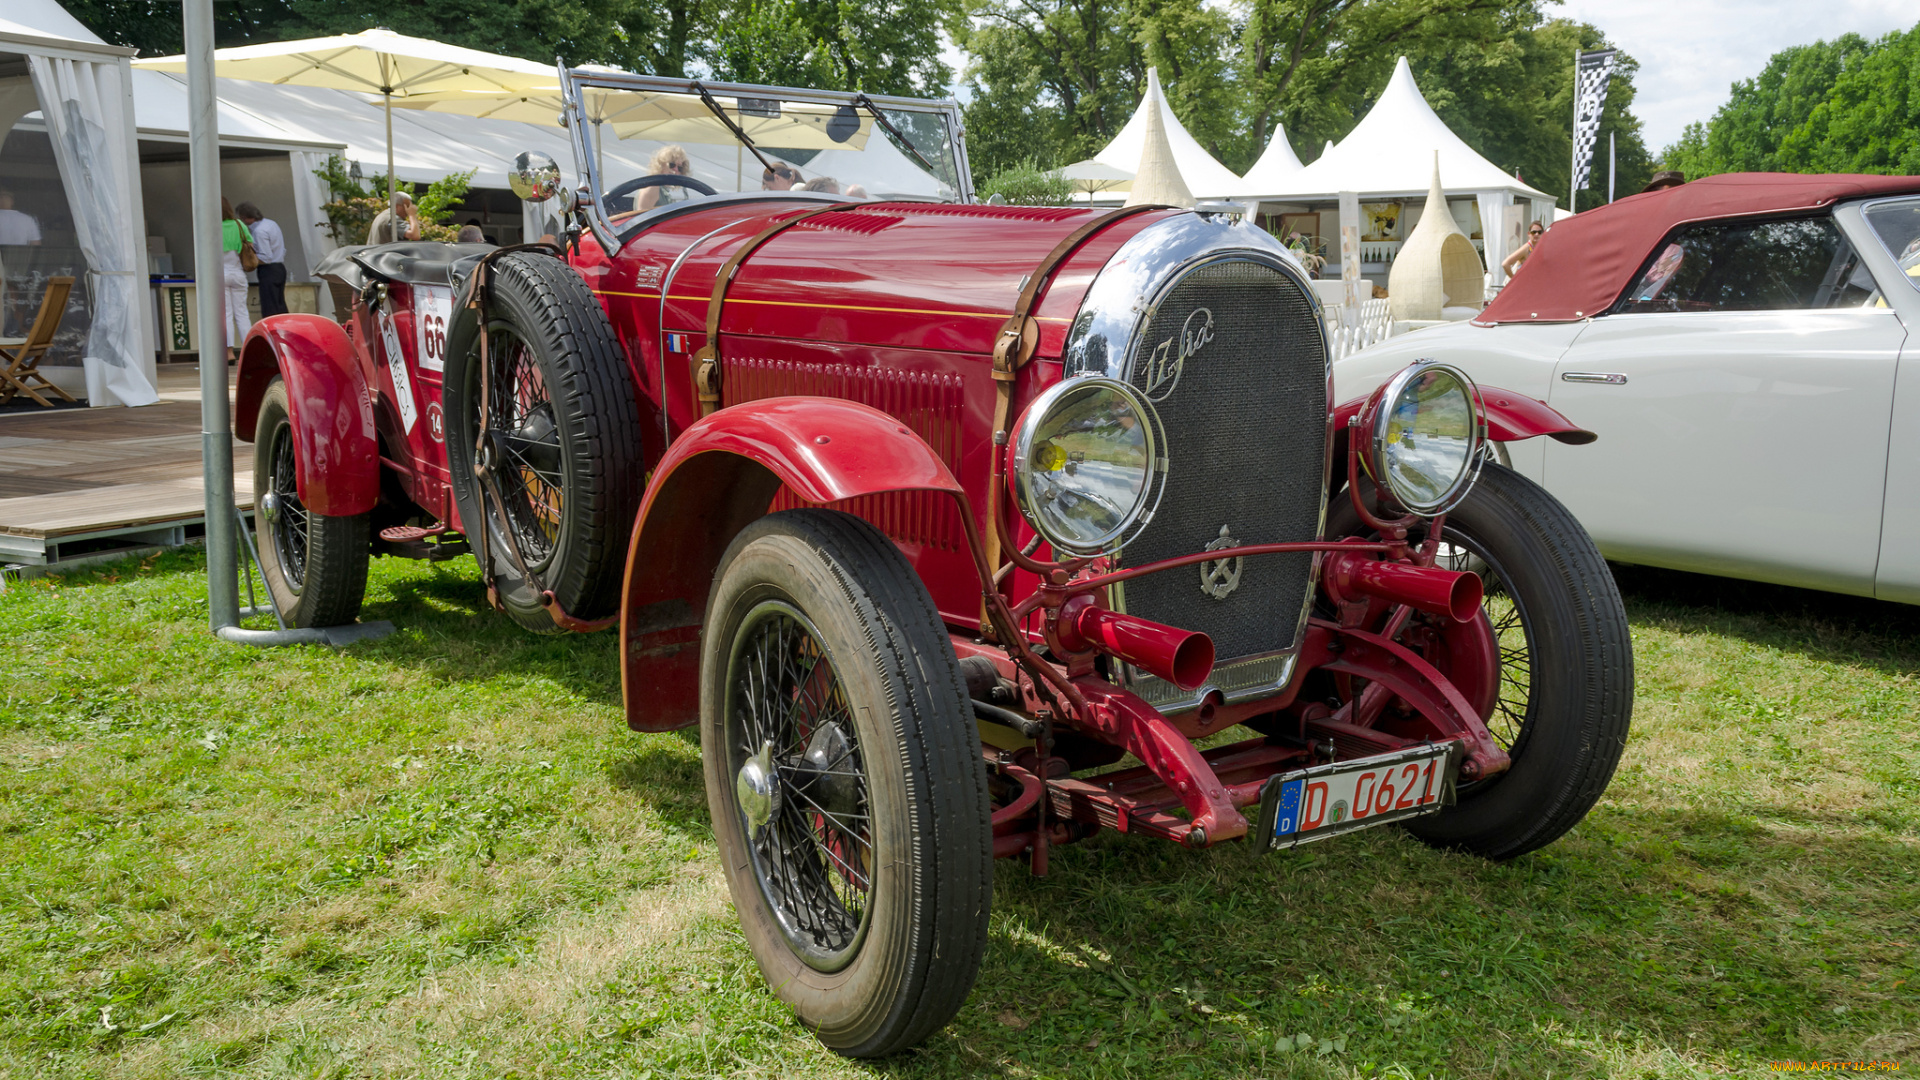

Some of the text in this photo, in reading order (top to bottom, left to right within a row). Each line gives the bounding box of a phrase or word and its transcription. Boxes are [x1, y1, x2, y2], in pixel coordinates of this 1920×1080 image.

[424, 314, 446, 361] 66
[430, 412, 442, 434] 14
[1301, 781, 1328, 832] D
[1352, 759, 1438, 819] 0621
[1281, 817, 1290, 832] D
